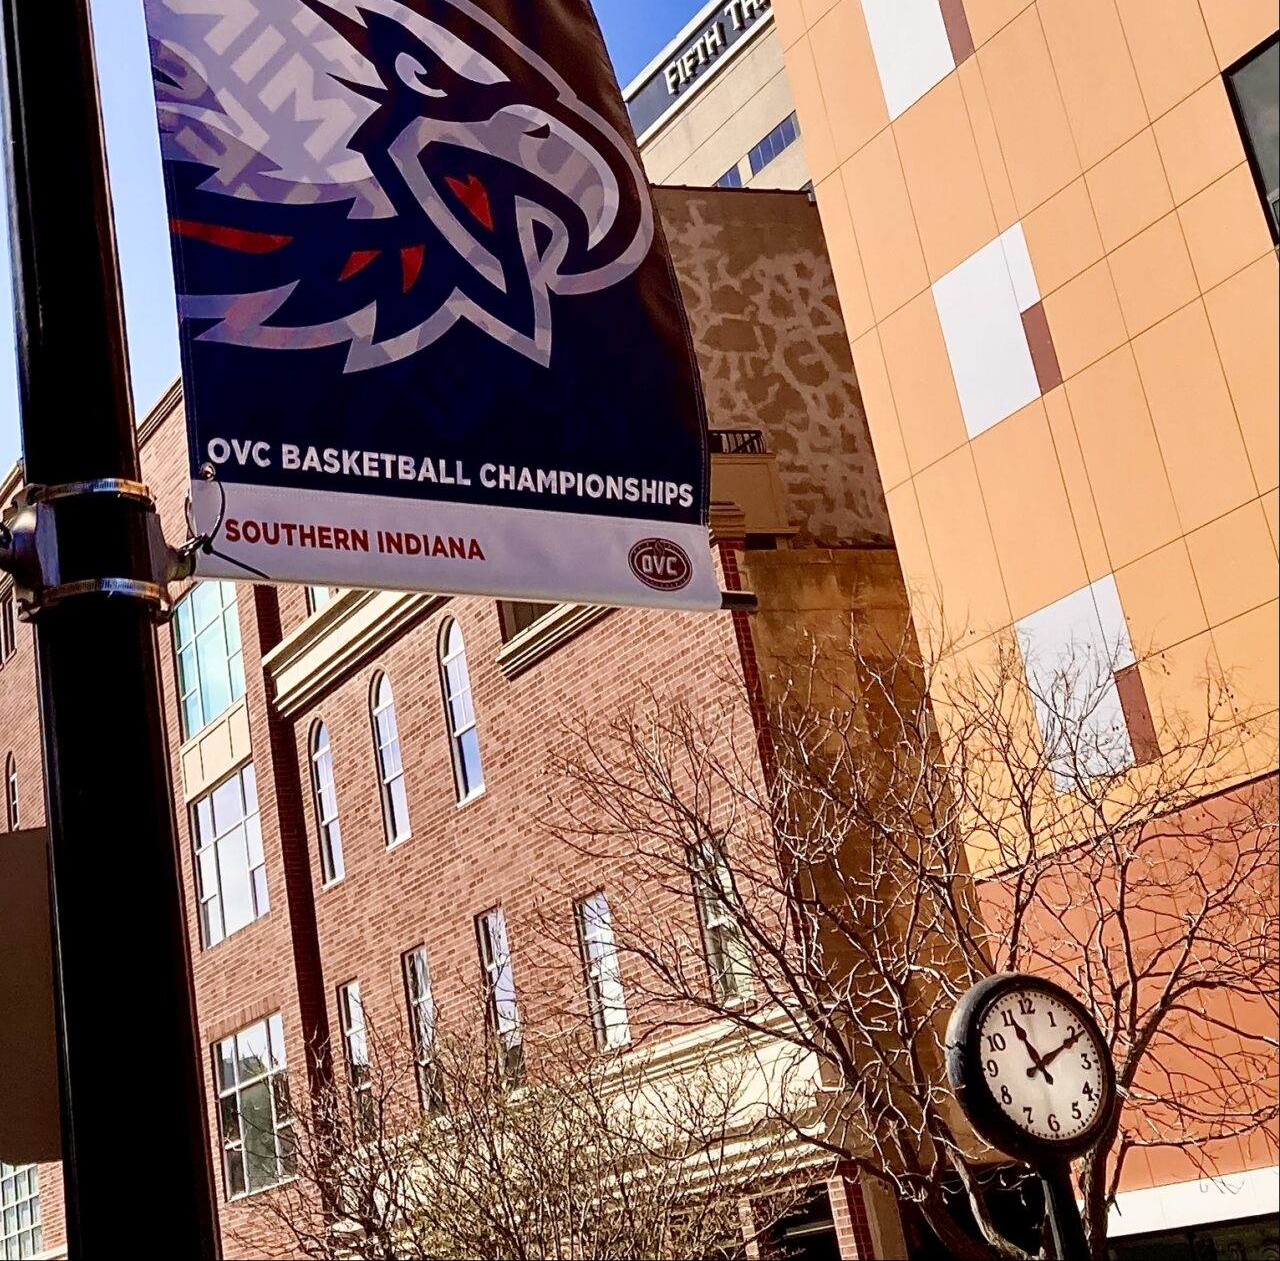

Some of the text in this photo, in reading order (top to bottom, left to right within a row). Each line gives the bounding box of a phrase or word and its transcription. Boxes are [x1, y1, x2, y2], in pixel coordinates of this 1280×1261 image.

[663, 21, 721, 95] FIFTH
[207, 437, 694, 508] OVC BASKETBALL CHAMPIONSHIPS
[225, 518, 486, 561] SOUTHERN INDIANA
[641, 554, 678, 576] OVC
[1018, 998, 1036, 1015] 12
[1047, 1011, 1057, 1027] 1
[986, 1032, 1006, 1053] 10
[986, 1059, 999, 1078] 9
[1080, 1052, 1092, 1070] 3
[1000, 1084, 1013, 1105] 8
[1081, 1080, 1094, 1101] 4
[1022, 1106, 1034, 1124] 7
[1071, 1100, 1082, 1120] 5
[1047, 1113, 1061, 1132] 6
